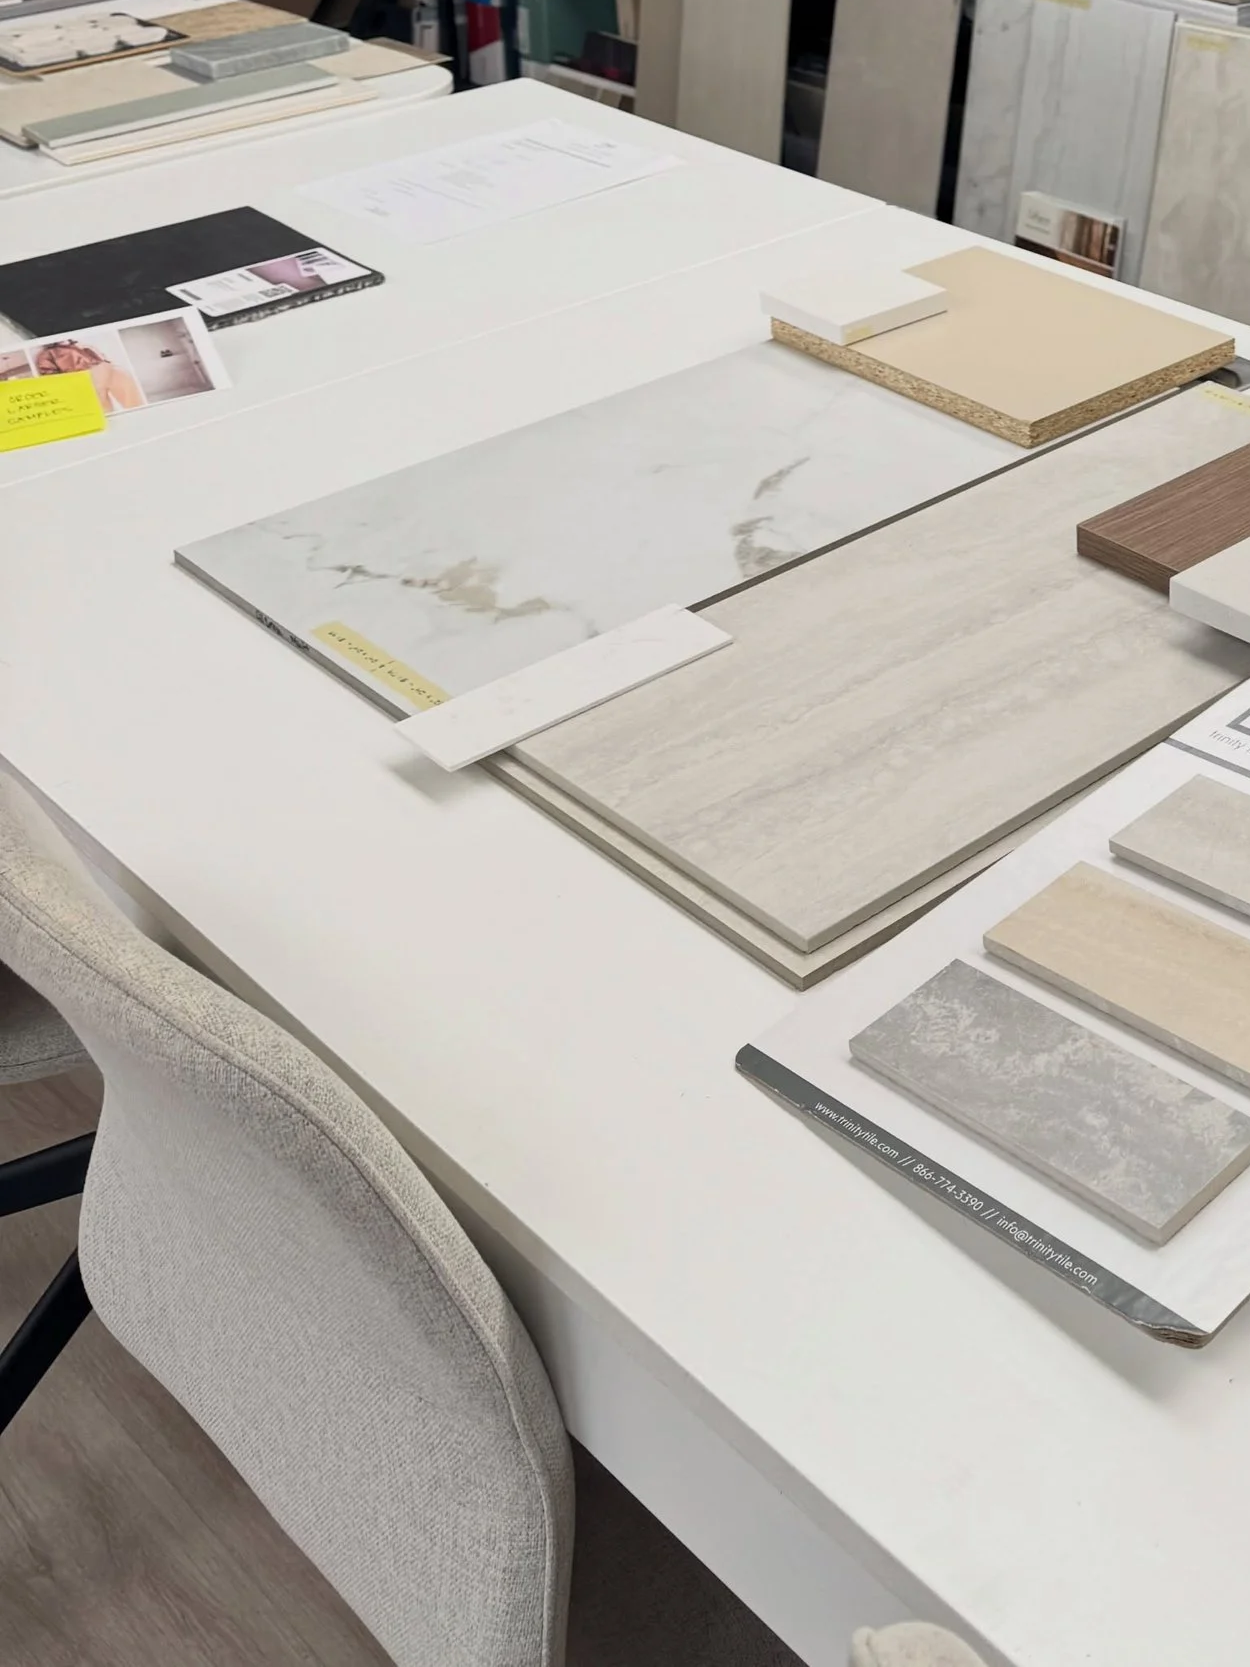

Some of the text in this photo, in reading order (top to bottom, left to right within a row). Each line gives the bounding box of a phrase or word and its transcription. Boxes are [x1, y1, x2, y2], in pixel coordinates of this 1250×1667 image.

[1209, 730, 1246, 751] trinity
[814, 1101, 899, 1160] www.trinitytile.com
[912, 1163, 984, 1211] 866-774-3390
[996, 1215, 1099, 1286] info@trinitytile.com
